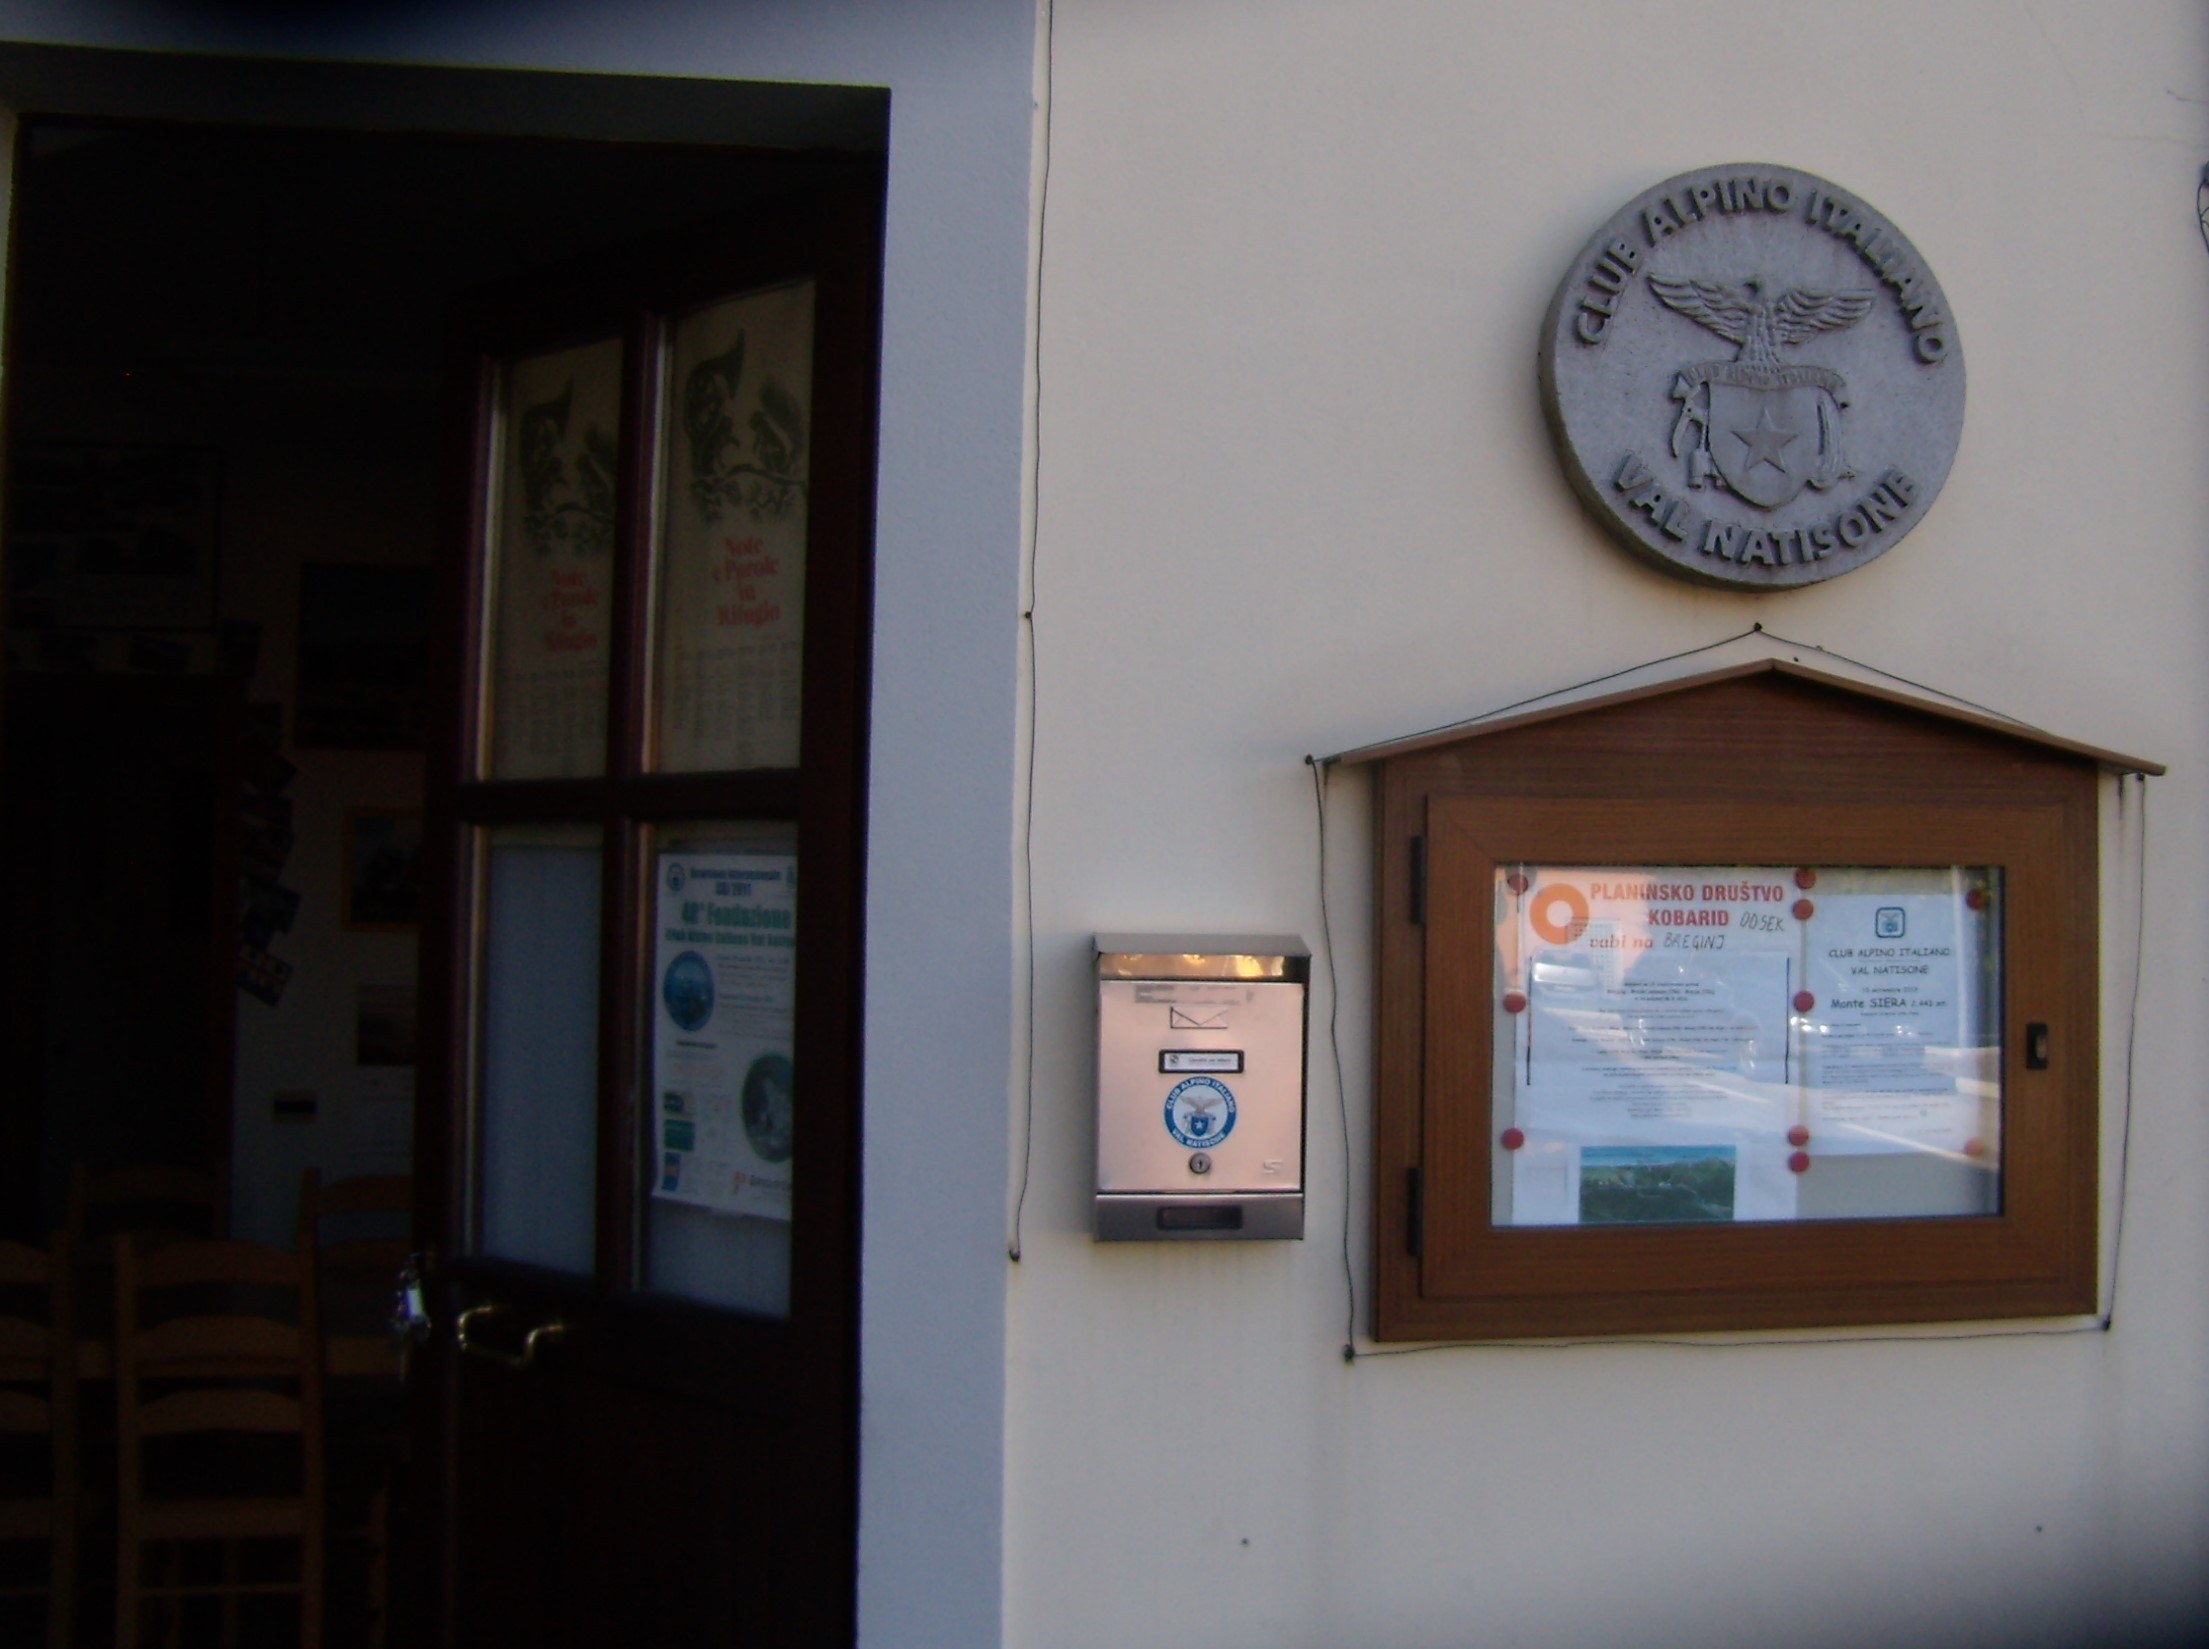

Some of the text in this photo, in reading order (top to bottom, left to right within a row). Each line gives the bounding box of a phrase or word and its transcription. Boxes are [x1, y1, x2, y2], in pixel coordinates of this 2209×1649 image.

[1574, 177, 1949, 365] CLUB ALPINO ITALIANO
[1613, 451, 1918, 567] VAL NATISONE
[1590, 881, 1784, 902] PLANINSKO DRUŠTVO
[1648, 909, 1730, 926] KOBARID
[1589, 934, 1654, 949] vabi na
[1664, 932, 1726, 950] BREGINJ
[1828, 947, 1951, 958] CLUB ALPINO ITALIANO
[1851, 965, 1929, 975] VAL NATISONE
[1831, 998, 1864, 1009] Monte
[1870, 997, 1907, 1008] SIERA
[1166, 1078, 1235, 1113] CLUB ALPINO ITALIANO
